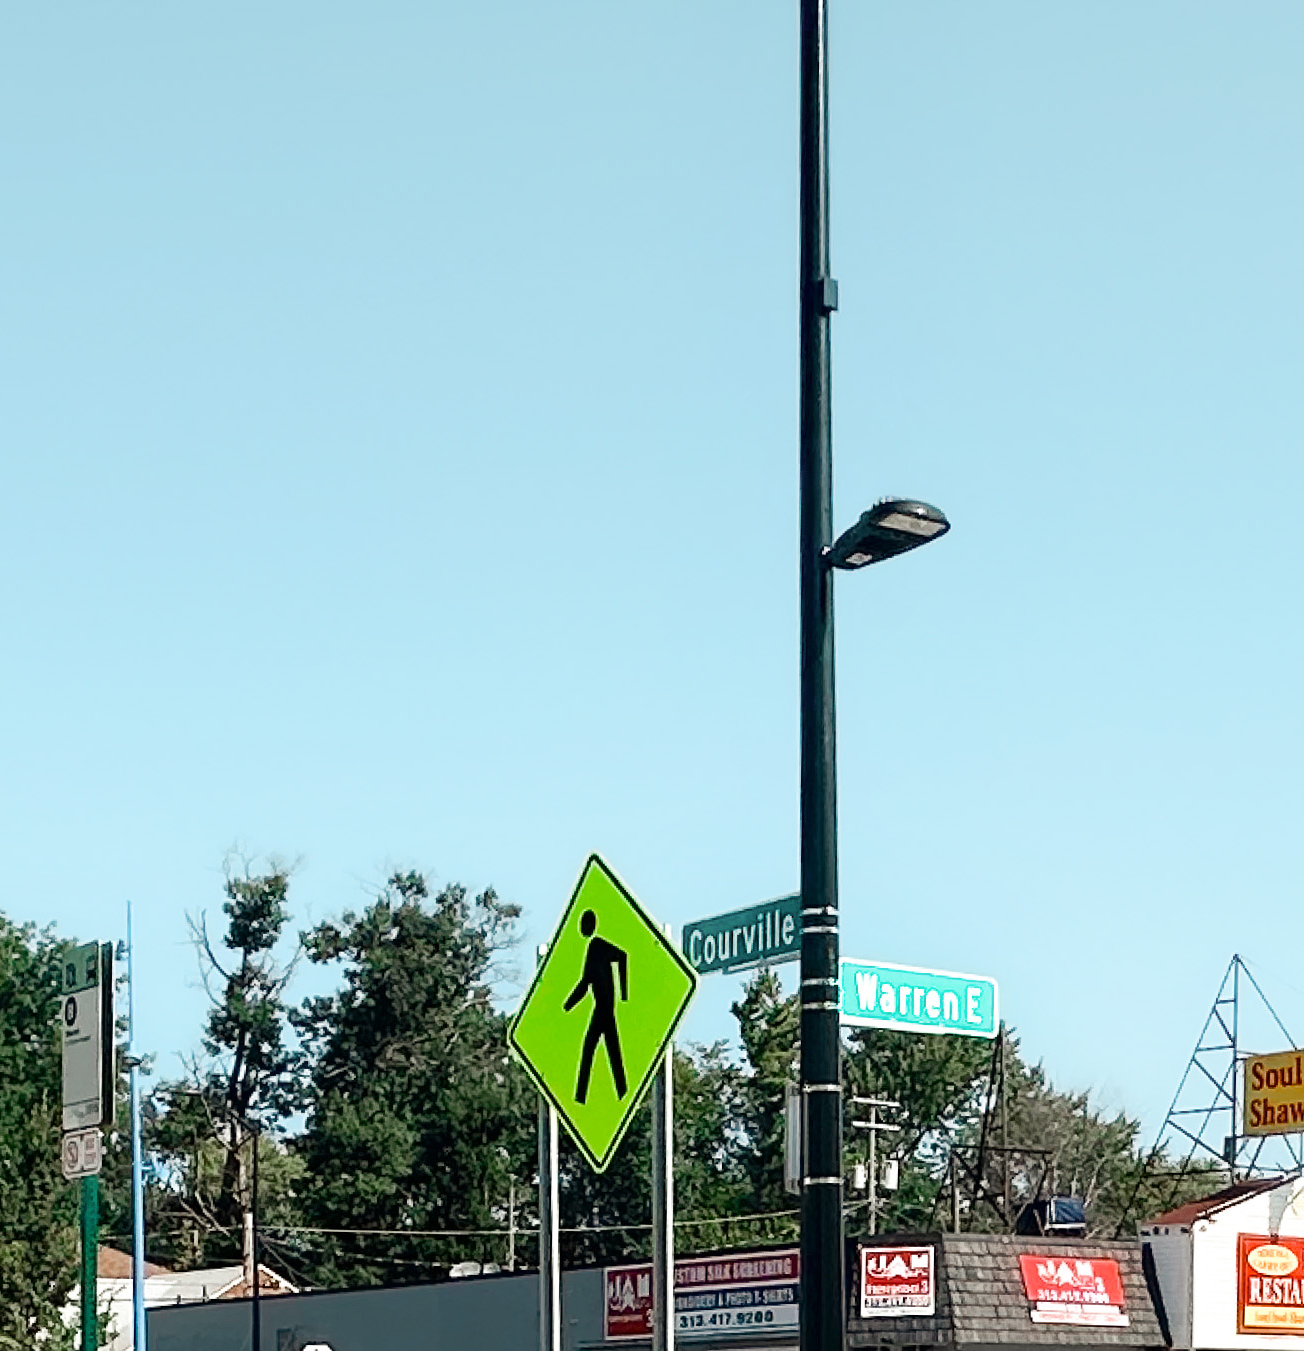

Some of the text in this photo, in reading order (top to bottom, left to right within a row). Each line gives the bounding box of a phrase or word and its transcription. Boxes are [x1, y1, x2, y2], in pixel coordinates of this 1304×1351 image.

[690, 910, 795, 967] Courville
[855, 972, 983, 1024] Warren E
[1251, 1056, 1303, 1091] Soul
[675, 1264, 706, 1285] STOM
[680, 1309, 774, 1329] 313.417.9200
